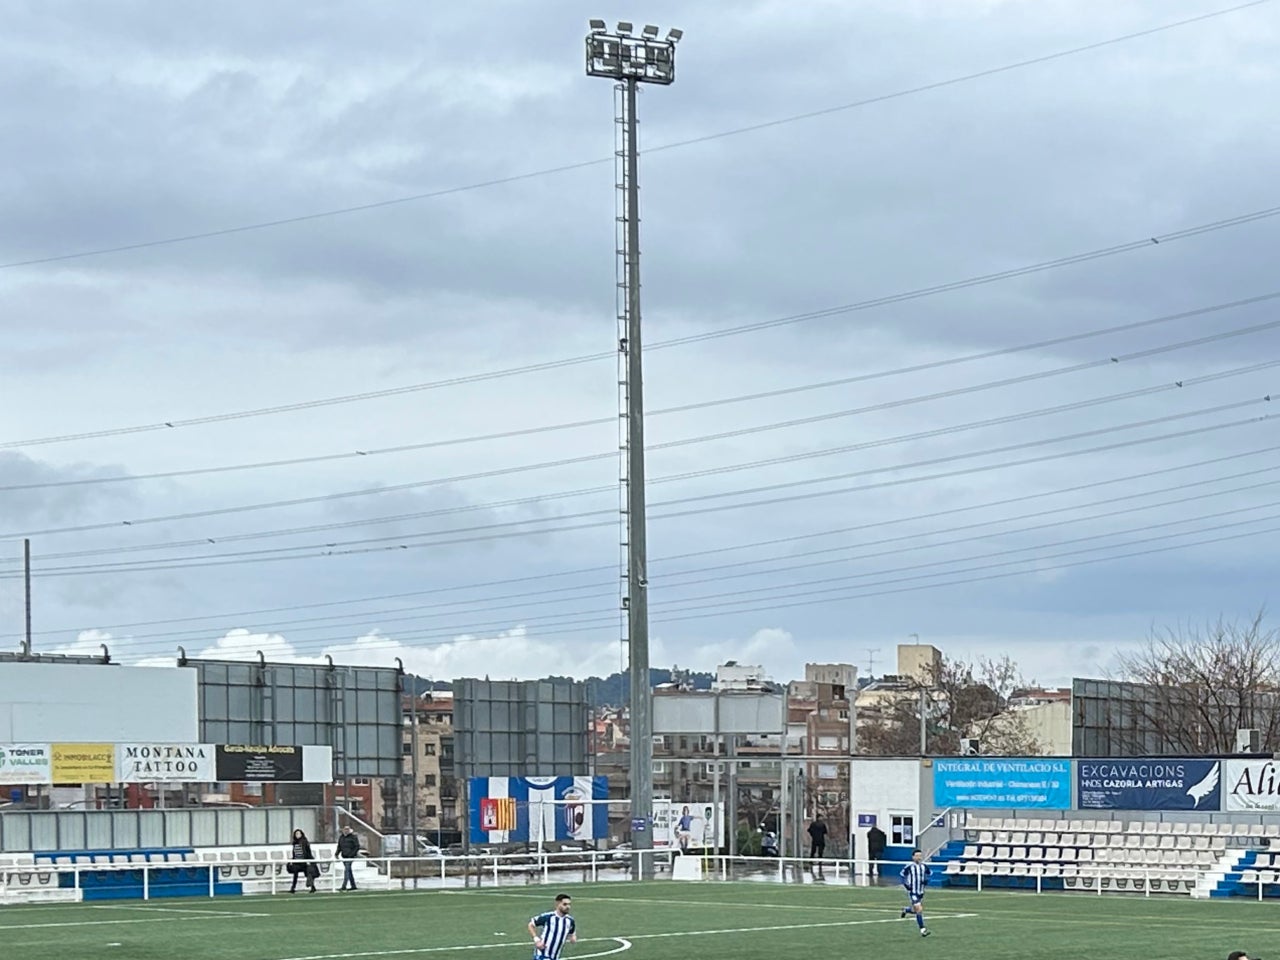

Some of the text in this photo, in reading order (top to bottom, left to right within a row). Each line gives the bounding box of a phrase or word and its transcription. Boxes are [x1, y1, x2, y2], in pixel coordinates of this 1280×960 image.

[9, 749, 44, 757] TONER
[126, 747, 206, 759] MONTANA
[134, 761, 198, 772] TATTOO
[937, 763, 981, 772] INTEGRAL
[983, 763, 996, 772] DE
[1081, 765, 1185, 778] EXCAVACIONS
[1081, 780, 1184, 788] HNOS CAZORLA ARTIGAS
